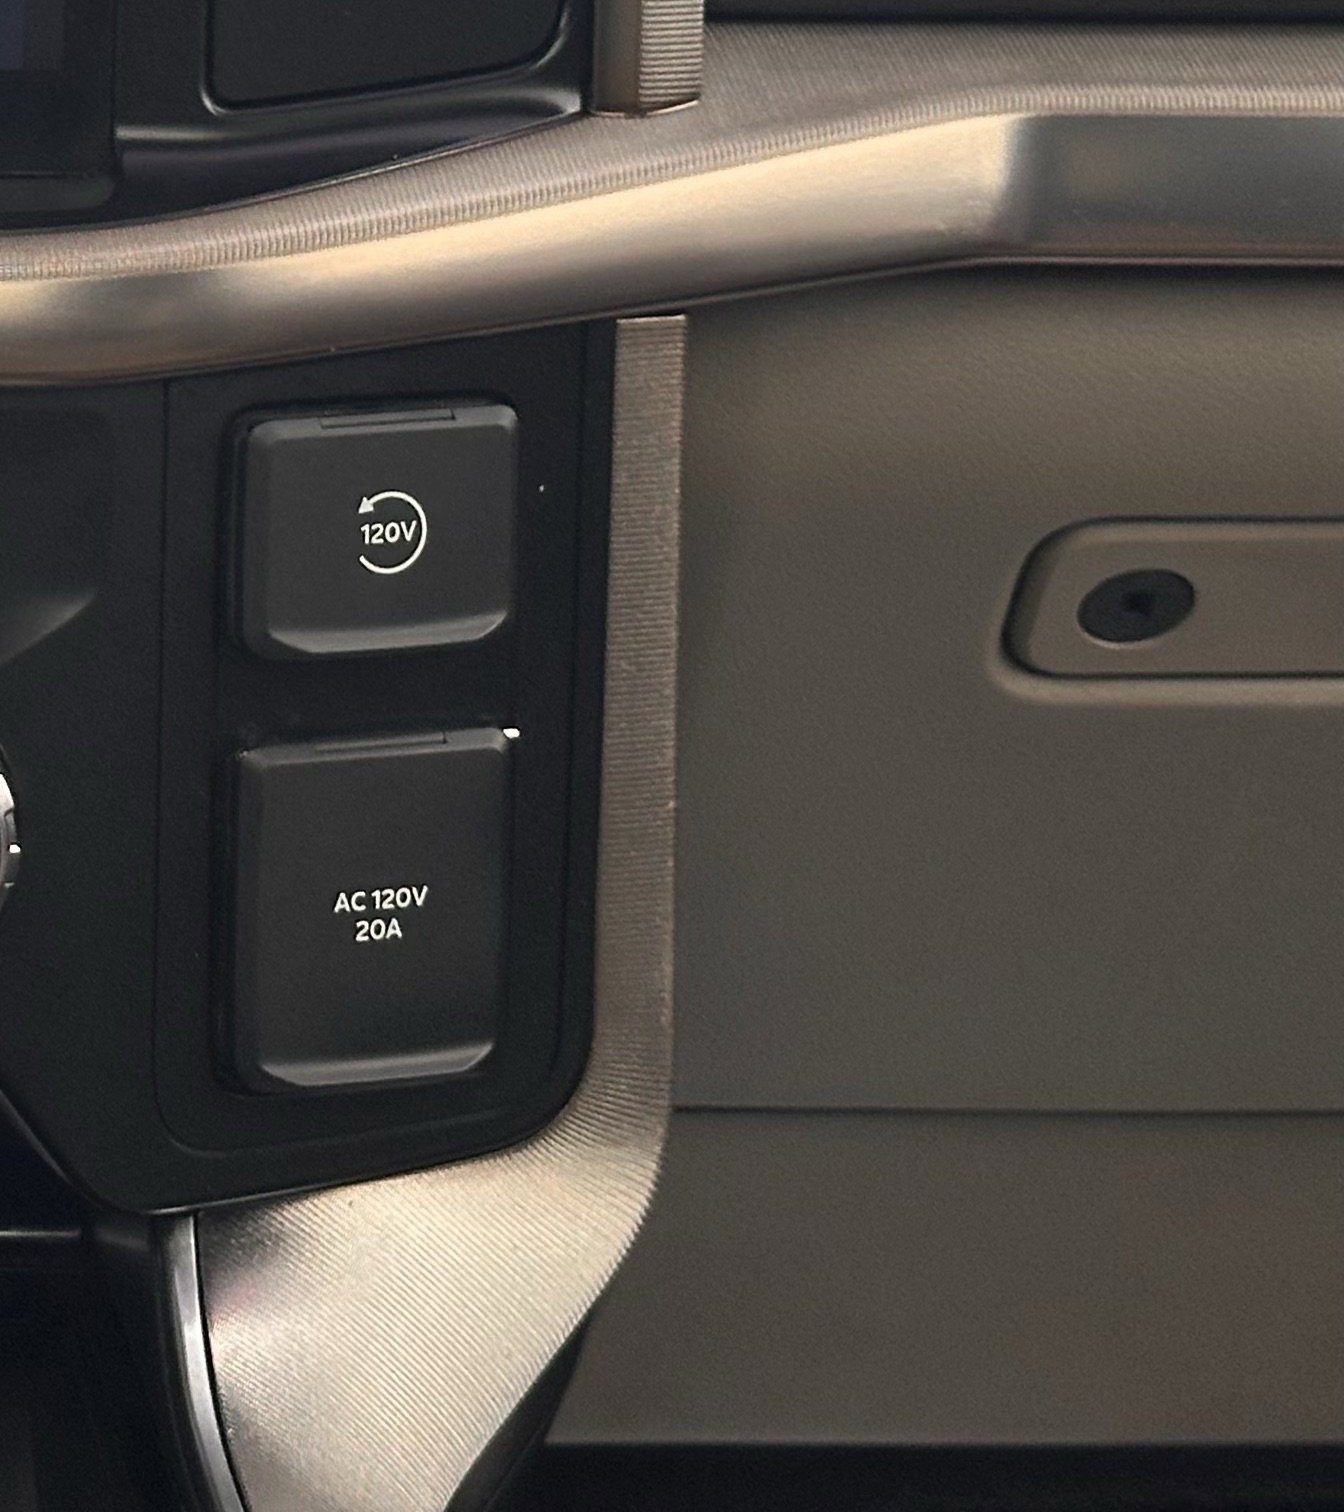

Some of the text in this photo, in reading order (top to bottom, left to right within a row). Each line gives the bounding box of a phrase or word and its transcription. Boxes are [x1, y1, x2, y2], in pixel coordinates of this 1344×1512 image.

[361, 520, 417, 544] 120V
[334, 886, 429, 914] AC 120V
[355, 917, 403, 942] 20A
